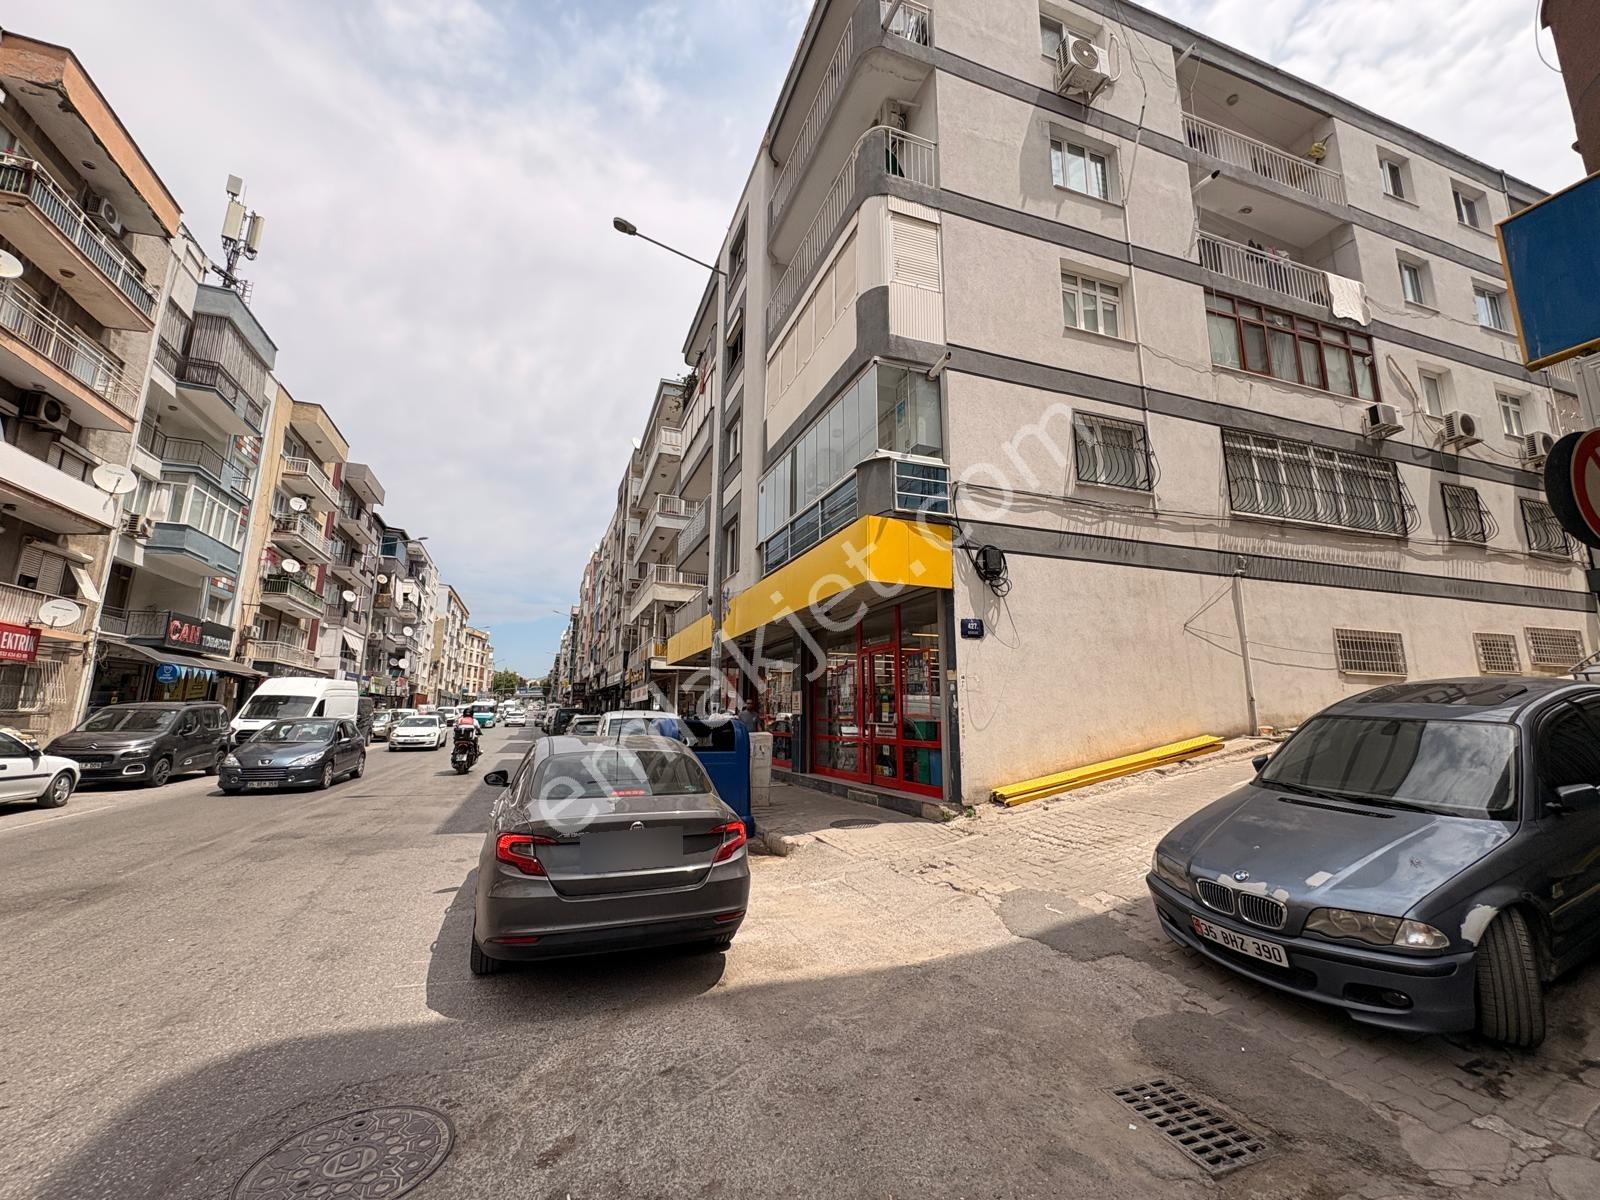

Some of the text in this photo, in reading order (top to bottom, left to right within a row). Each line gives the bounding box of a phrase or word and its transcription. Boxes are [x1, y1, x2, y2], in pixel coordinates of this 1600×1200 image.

[0, 630, 36, 652] EKTRİK
[168, 619, 202, 645] CAN
[1200, 923, 1283, 963] 35 BHZ 390
